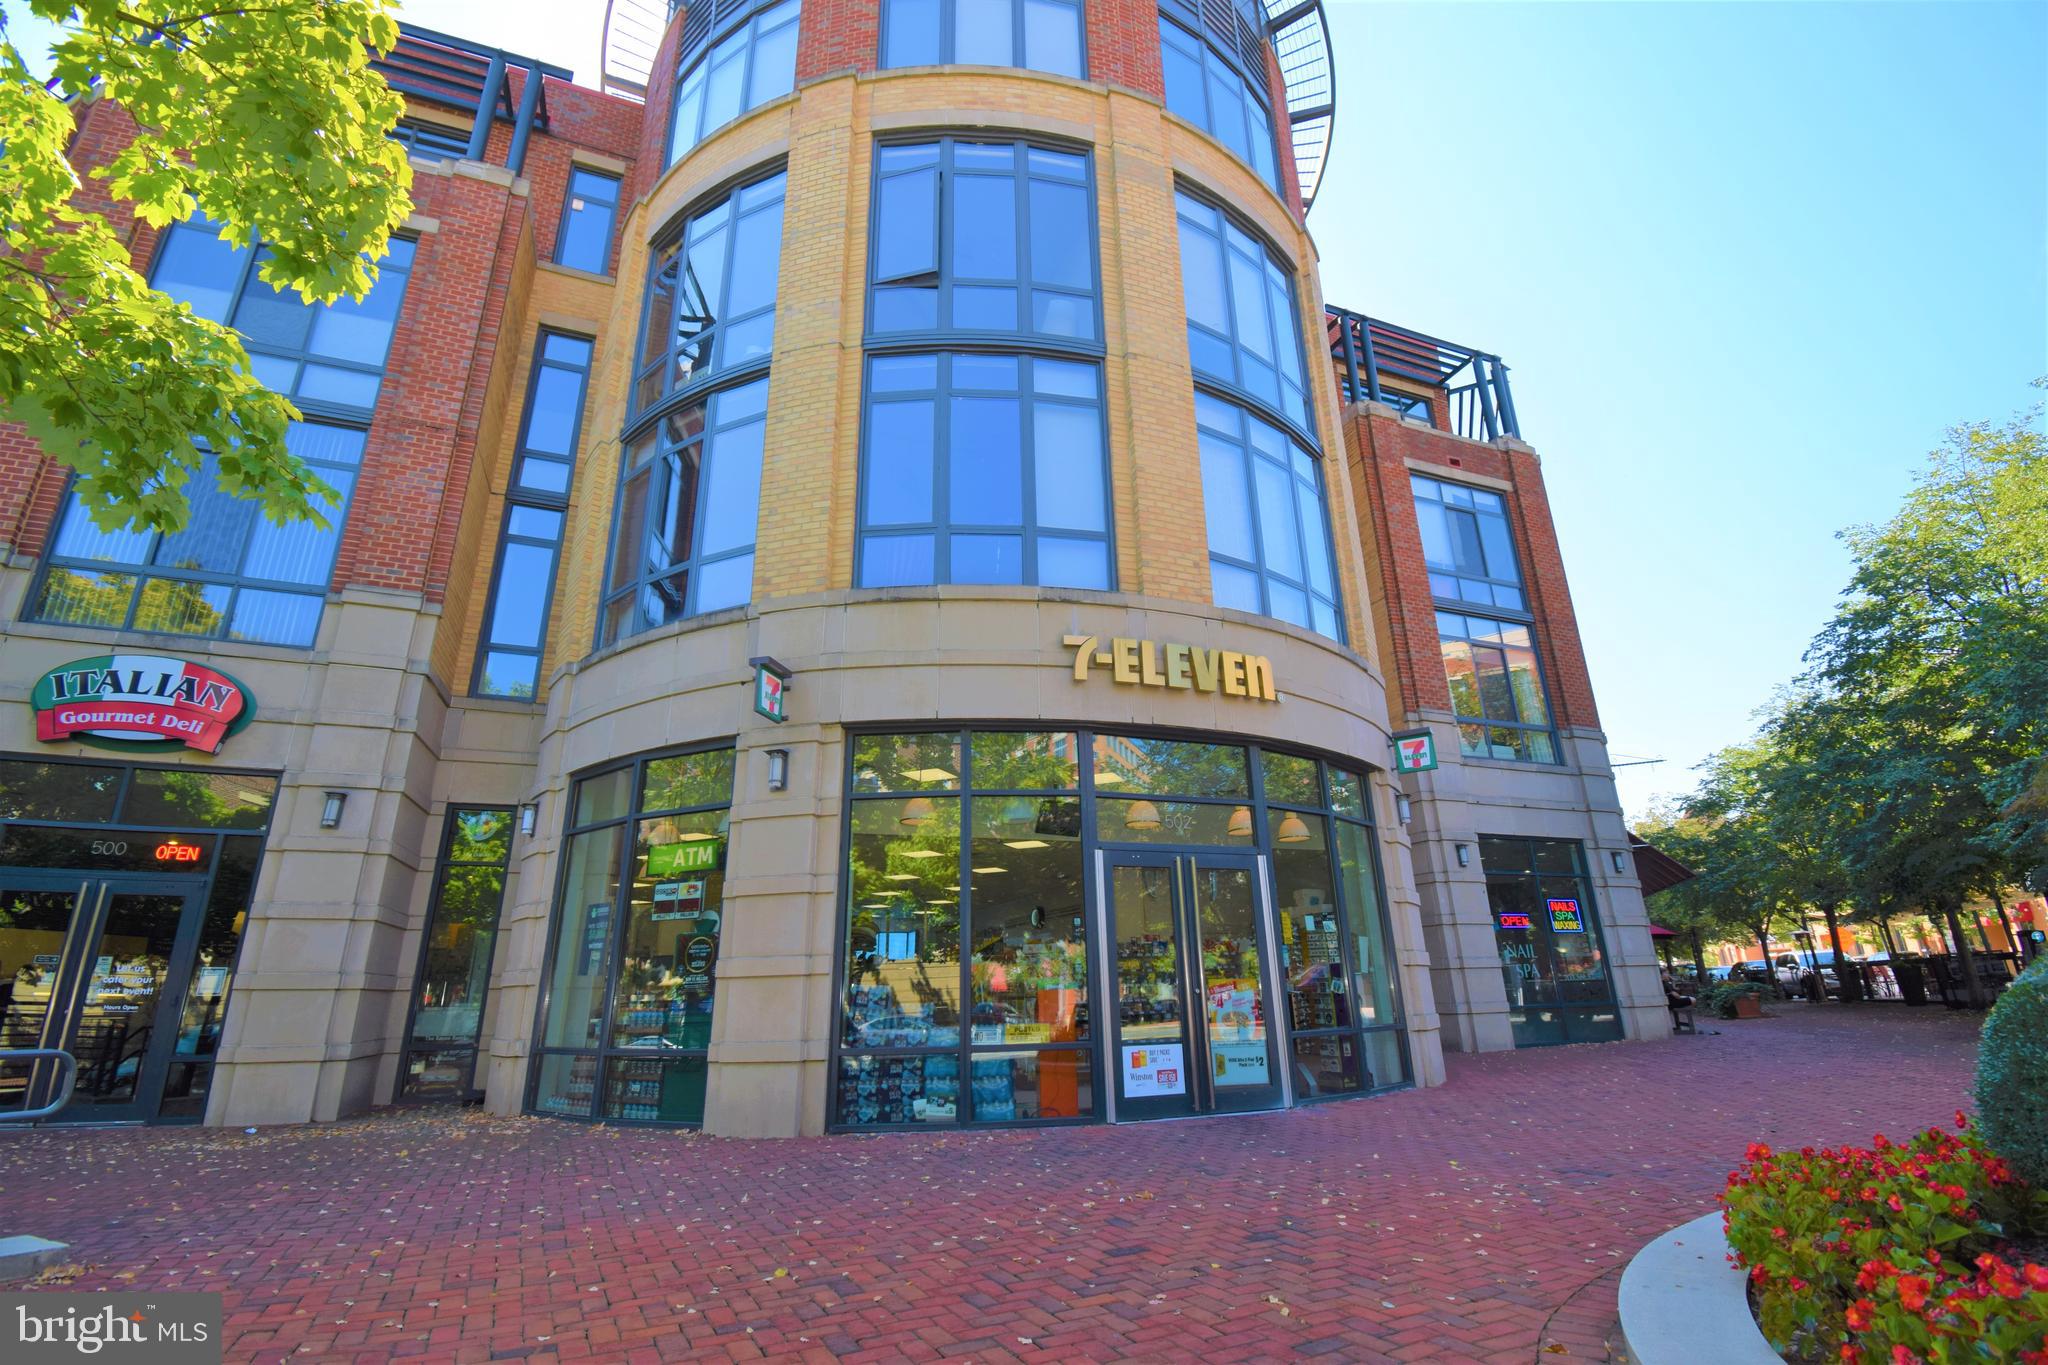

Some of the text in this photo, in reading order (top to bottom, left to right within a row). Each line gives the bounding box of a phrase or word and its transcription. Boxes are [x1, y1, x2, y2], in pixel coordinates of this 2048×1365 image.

[52, 669, 234, 713] ITALIAN
[60, 711, 205, 735] Gourmet Deli
[1402, 740, 1425, 768] 7
[91, 840, 127, 856] 500
[155, 846, 200, 861] OPEN
[673, 846, 713, 867] ATM
[1550, 901, 1576, 912] NAILS
[1501, 916, 1530, 926] OPEN
[1555, 911, 1575, 921] SPA
[1553, 920, 1580, 930] WAXING
[1506, 943, 1538, 958] NAIL
[1516, 963, 1541, 979] SPA
[103, 976, 128, 984] cater
[97, 987, 154, 995] next event!
[1130, 1072, 1153, 1081] Winston
